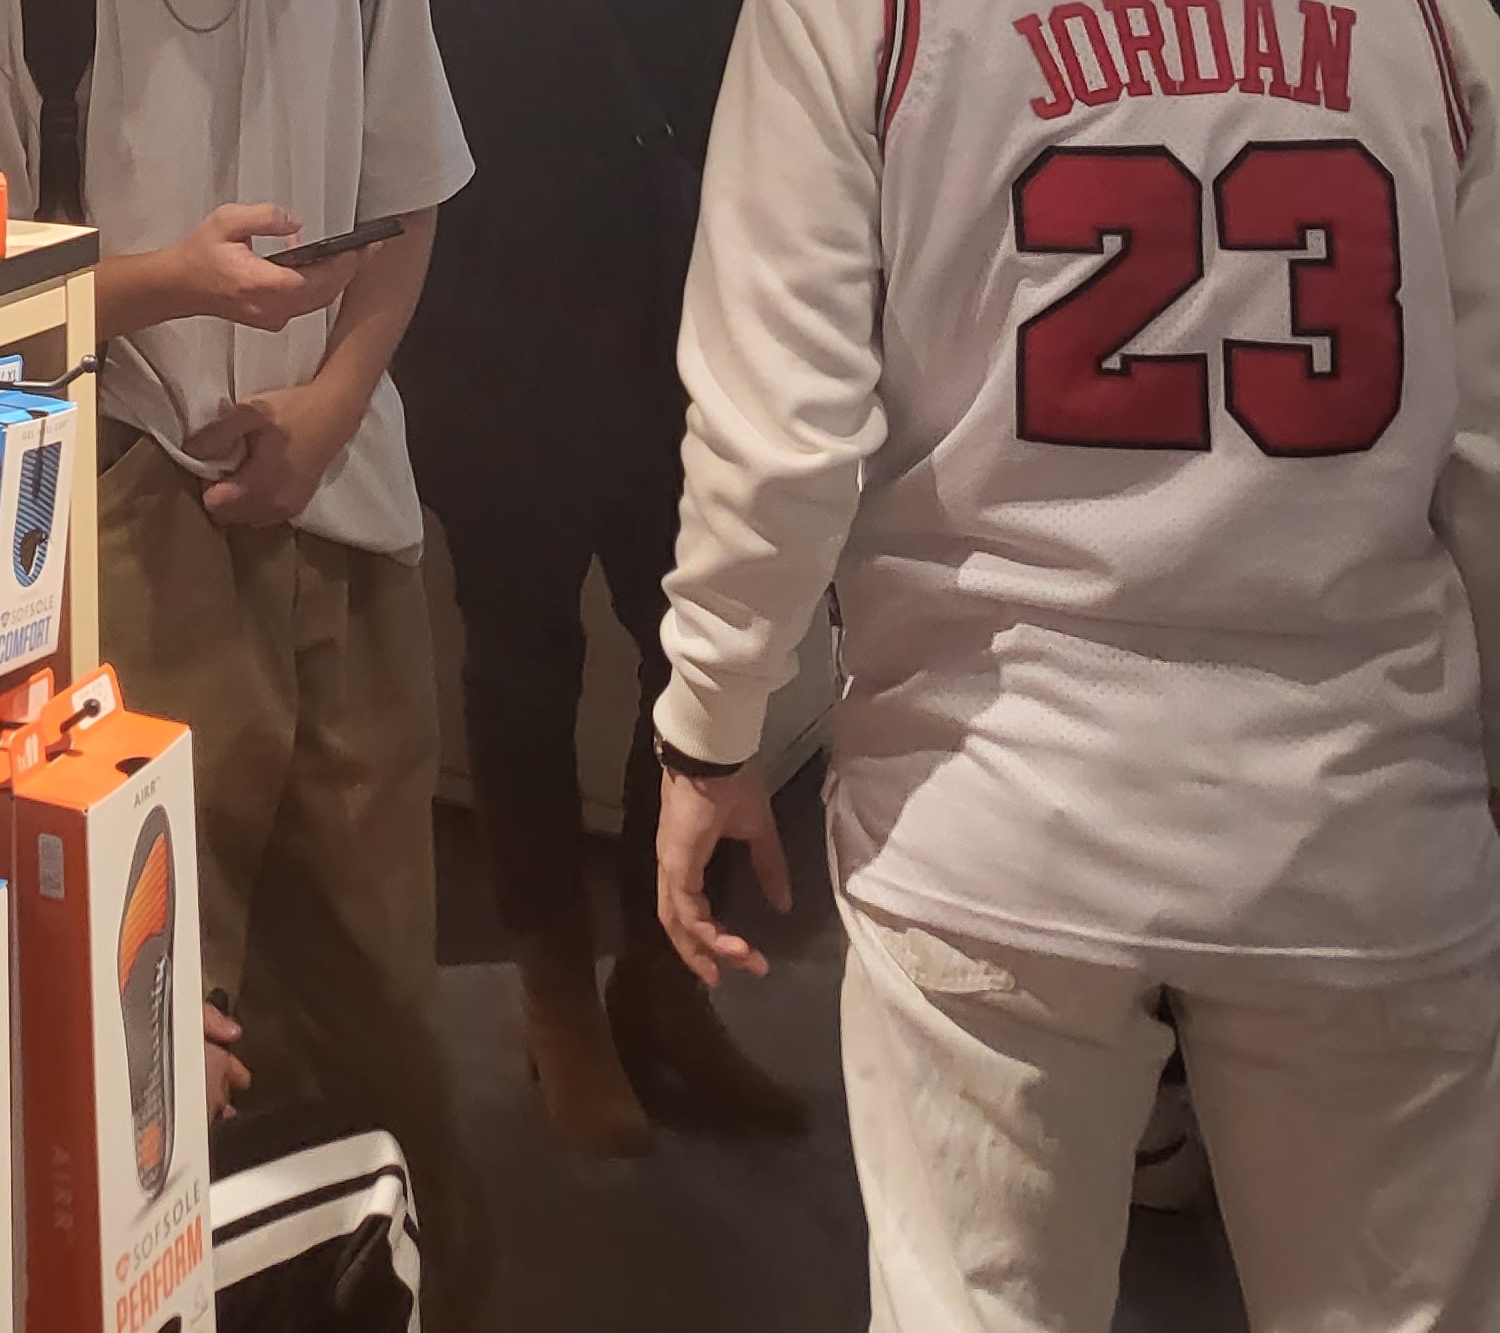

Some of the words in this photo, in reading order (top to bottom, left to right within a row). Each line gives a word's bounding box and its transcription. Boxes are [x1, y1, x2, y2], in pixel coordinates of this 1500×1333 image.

[1011, 138, 1404, 459] 23
[133, 781, 157, 808] AIRR
[116, 1213, 204, 1333] PERFORM
[133, 1181, 200, 1270] SOFSOLE
